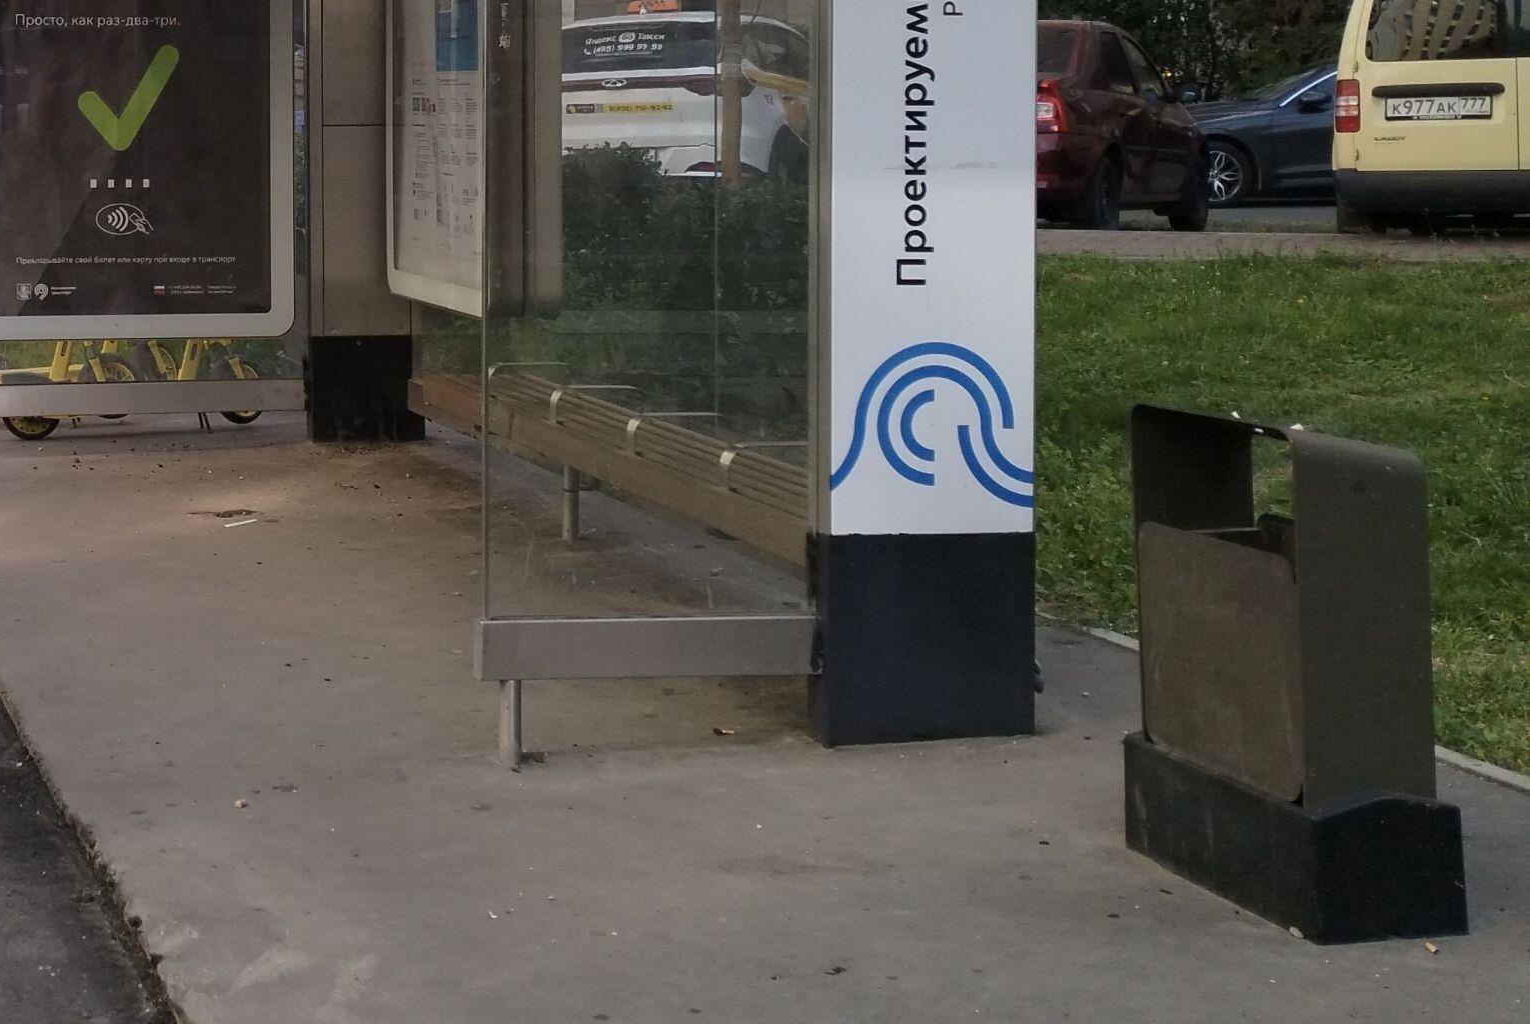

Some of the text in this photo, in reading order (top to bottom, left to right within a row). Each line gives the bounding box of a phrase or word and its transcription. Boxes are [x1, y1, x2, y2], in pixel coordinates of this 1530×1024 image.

[15, 13, 181, 28] Просто, как раз-два-три.
[1460, 97, 1487, 110] 777
